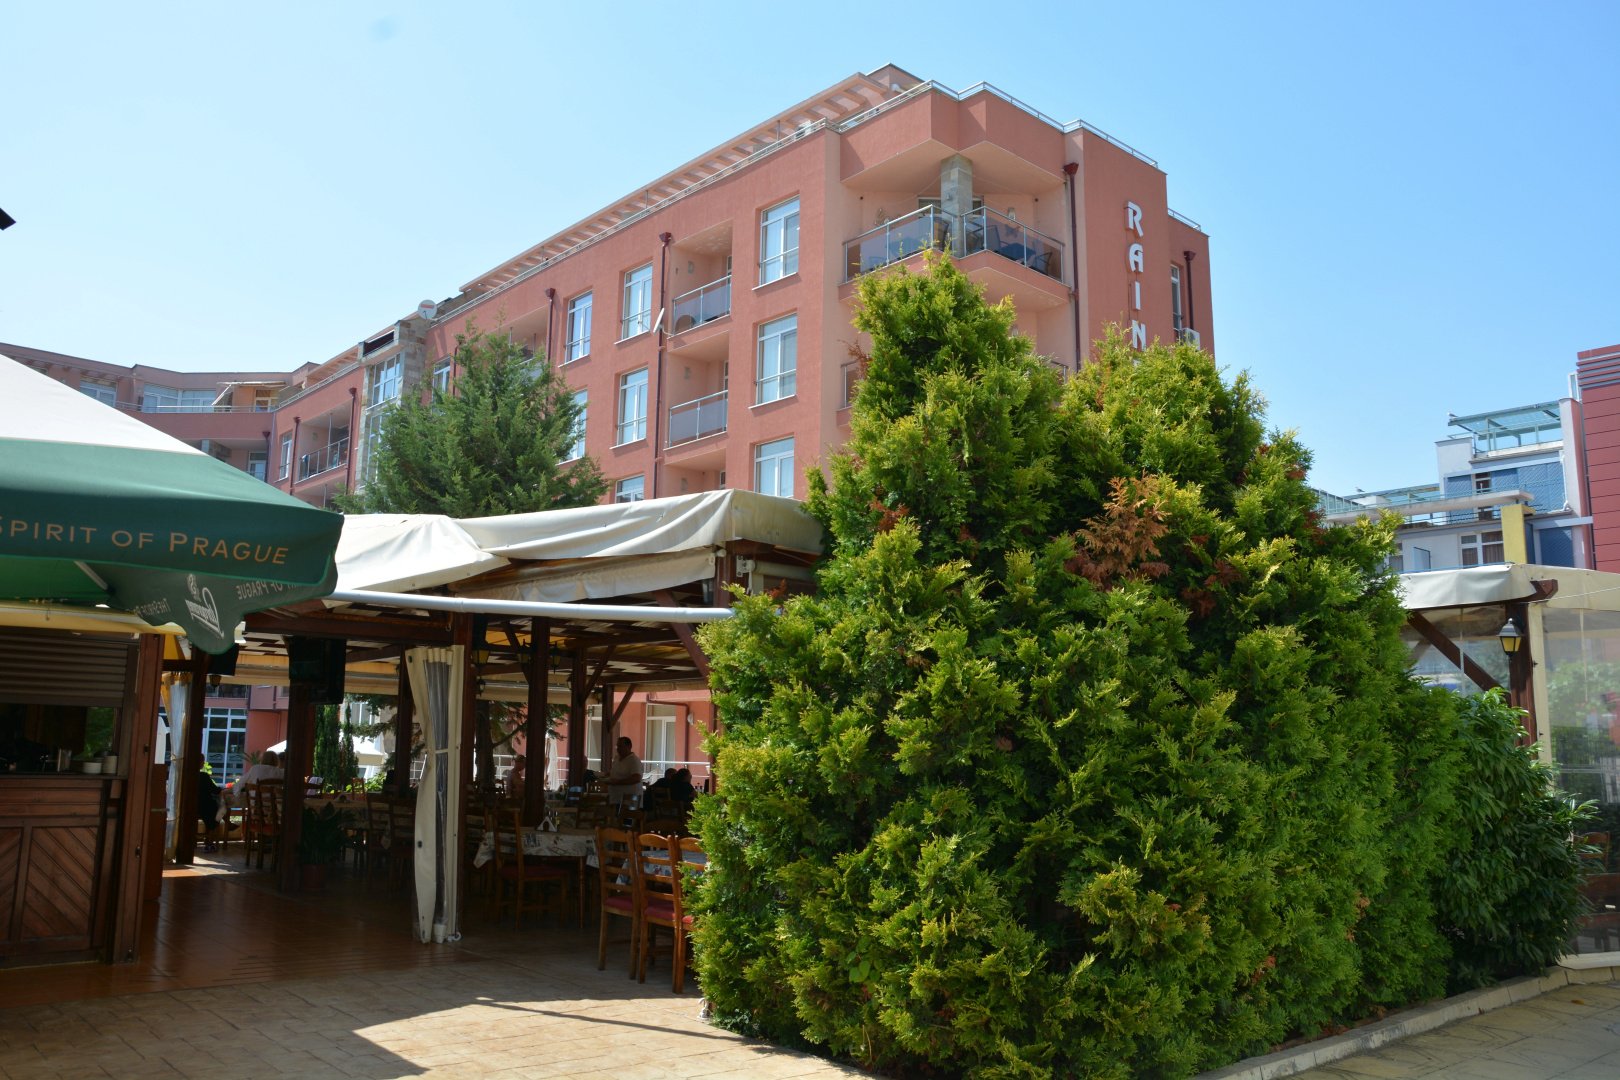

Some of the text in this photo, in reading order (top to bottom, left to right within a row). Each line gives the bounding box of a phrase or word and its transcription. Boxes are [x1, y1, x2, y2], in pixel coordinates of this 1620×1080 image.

[1124, 200, 1147, 367] RAIN
[0, 515, 289, 565] PIRIT OF PRAGUE
